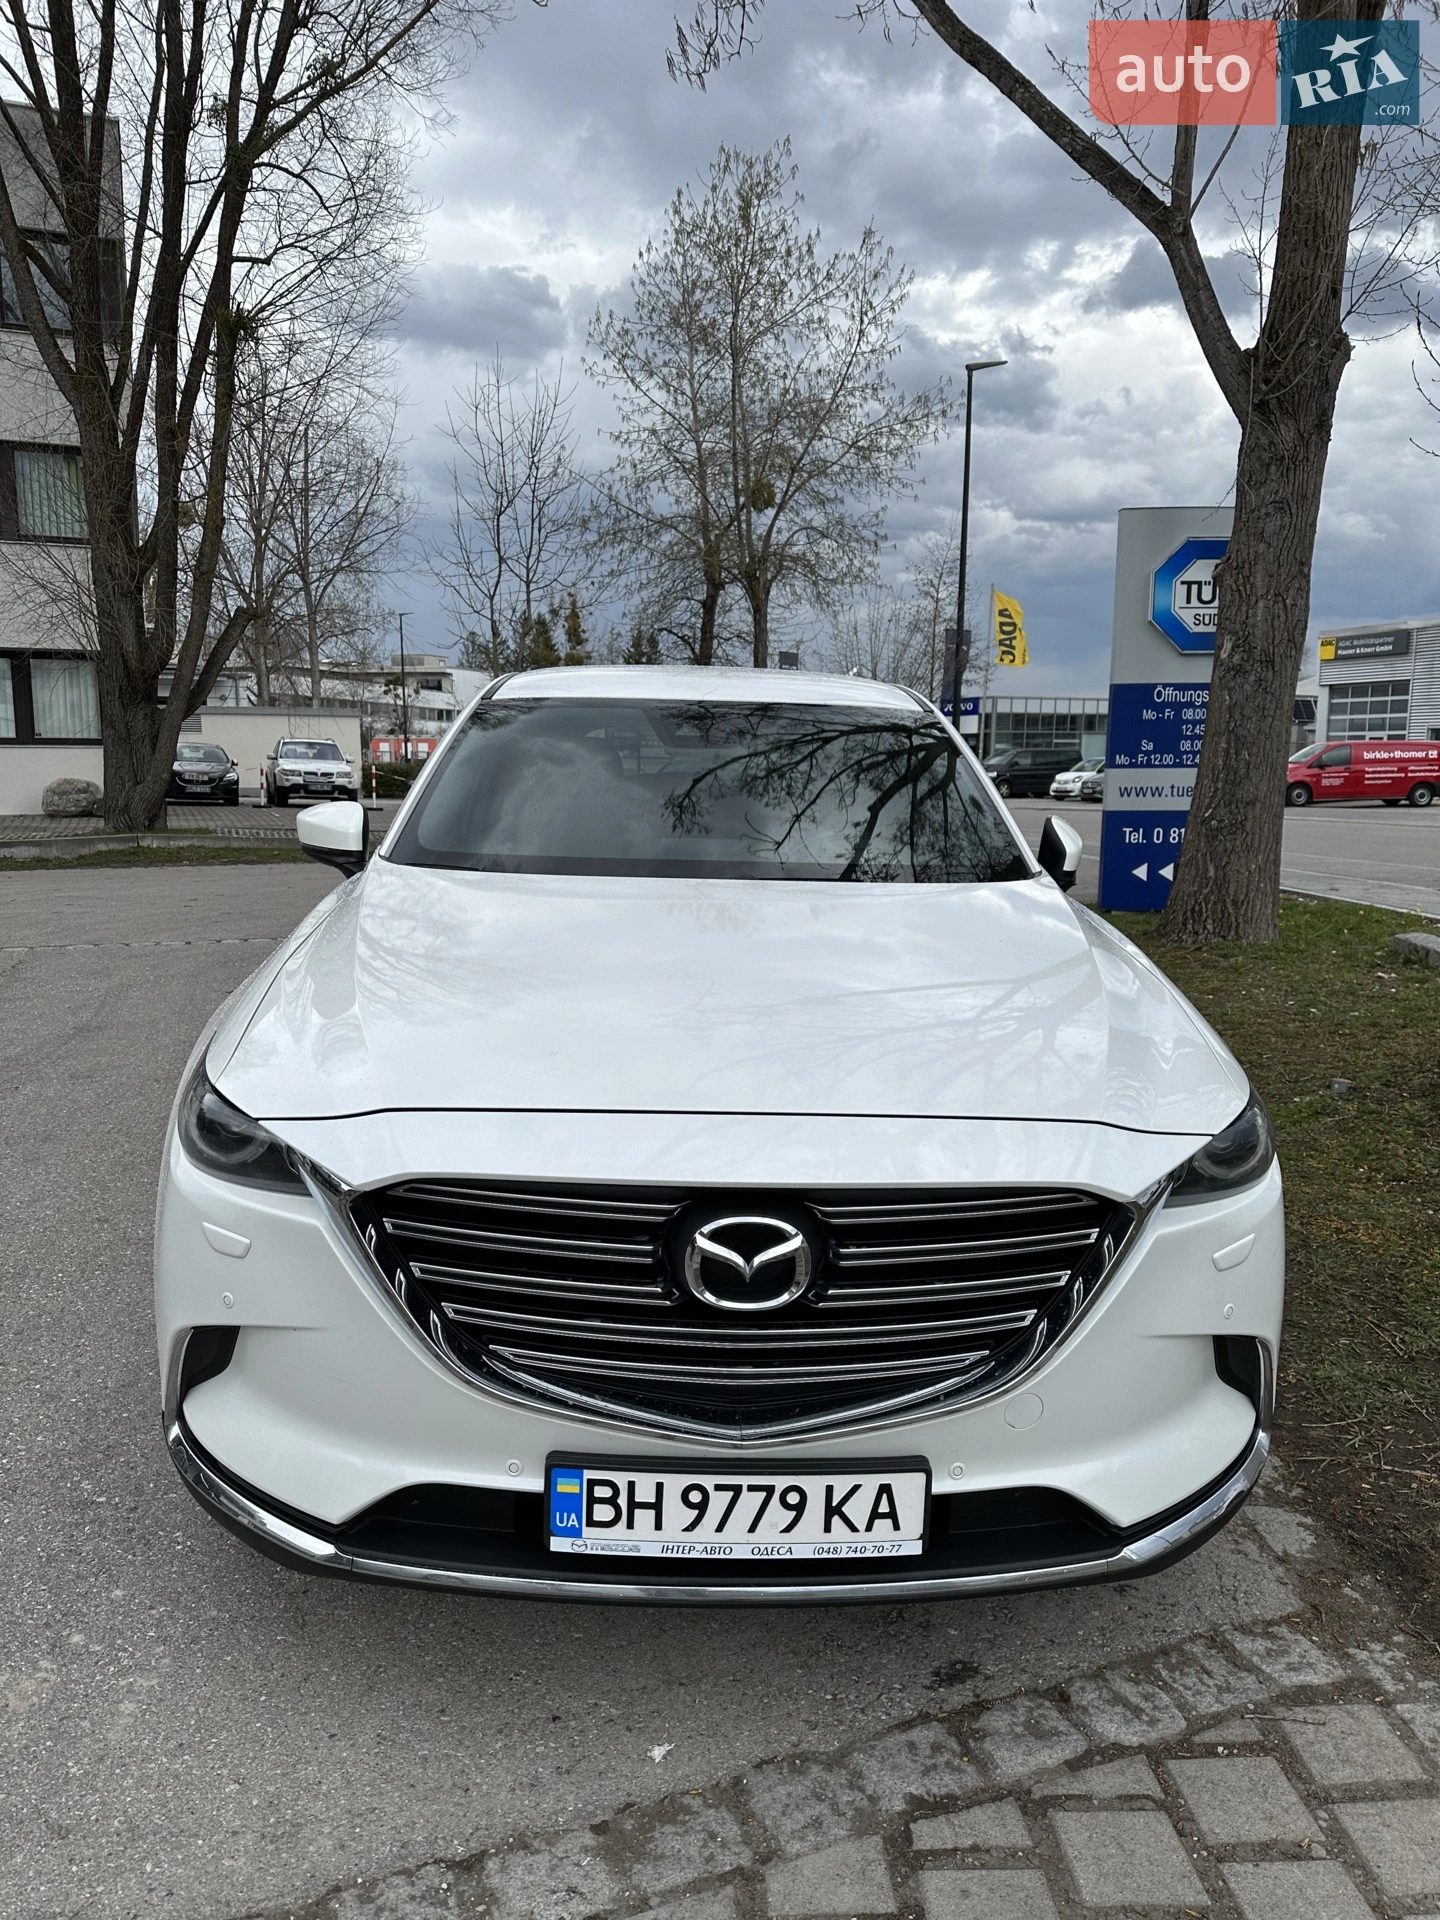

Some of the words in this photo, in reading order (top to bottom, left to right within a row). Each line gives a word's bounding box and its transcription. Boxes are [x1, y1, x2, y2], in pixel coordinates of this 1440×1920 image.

[1142, 709, 1157, 720] Mo
[1164, 709, 1175, 720] Fr
[1181, 708, 1207, 720] 08.00
[1181, 724, 1206, 735] 12.45
[1141, 739, 1154, 751] Sa
[1115, 754, 1130, 765] Mo
[1137, 754, 1148, 765] Fr
[1150, 754, 1174, 765] 12.00
[1363, 750, 1427, 759] birkle+thomer
[1118, 784, 1194, 798] www.tue
[1122, 827, 1147, 844] Tel.
[1153, 827, 1163, 844] 0
[585, 1477, 664, 1531] BH
[681, 1483, 808, 1533] 9779
[823, 1483, 901, 1534] KA
[555, 1512, 580, 1528] UA
[590, 1542, 641, 1553] mazda
[661, 1545, 733, 1556] ІНТЕР-АВТО
[751, 1546, 794, 1556] ОДЕСА
[813, 1545, 843, 1556] (048)
[846, 1544, 902, 1555] 740-70-77
